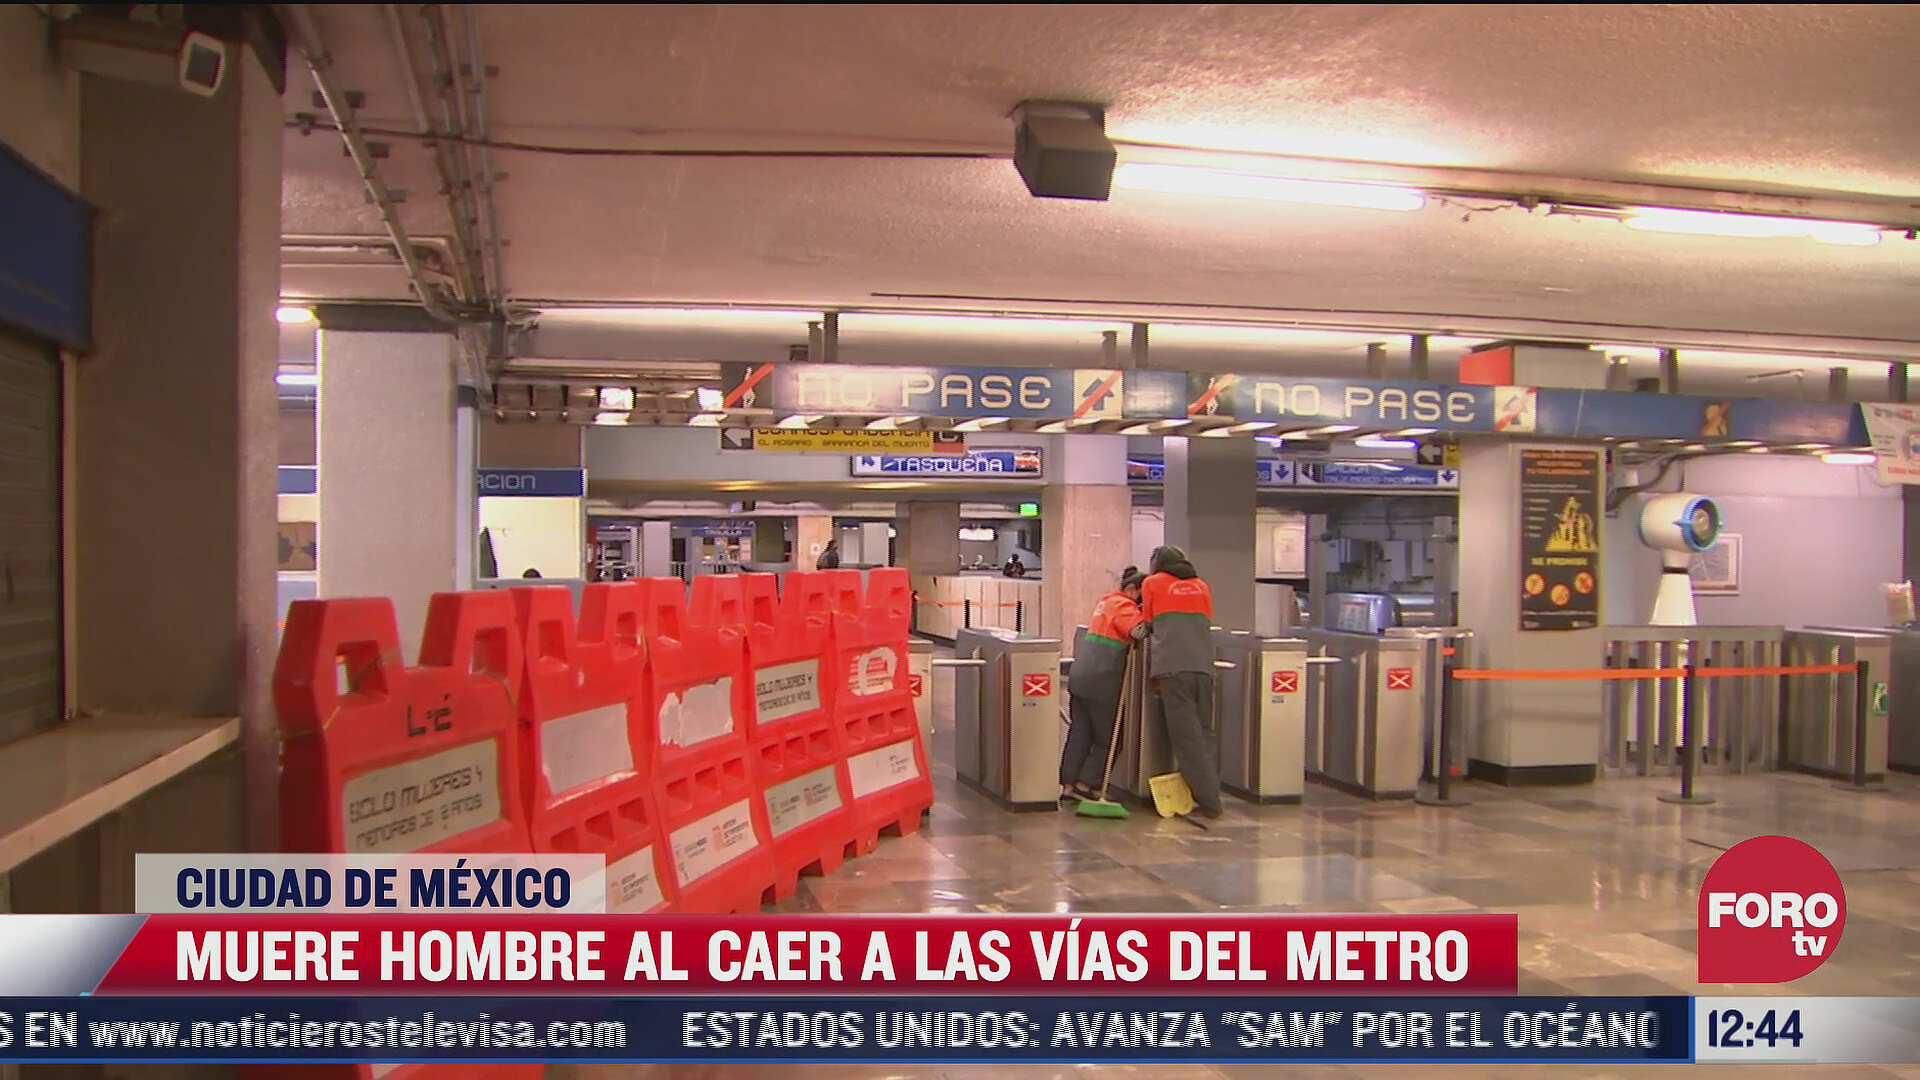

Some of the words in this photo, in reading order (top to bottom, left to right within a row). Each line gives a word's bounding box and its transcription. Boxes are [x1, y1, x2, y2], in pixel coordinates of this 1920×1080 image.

[902, 374, 1052, 411] PASE
[1254, 381, 1321, 417] NO
[1344, 385, 1476, 423] PASE
